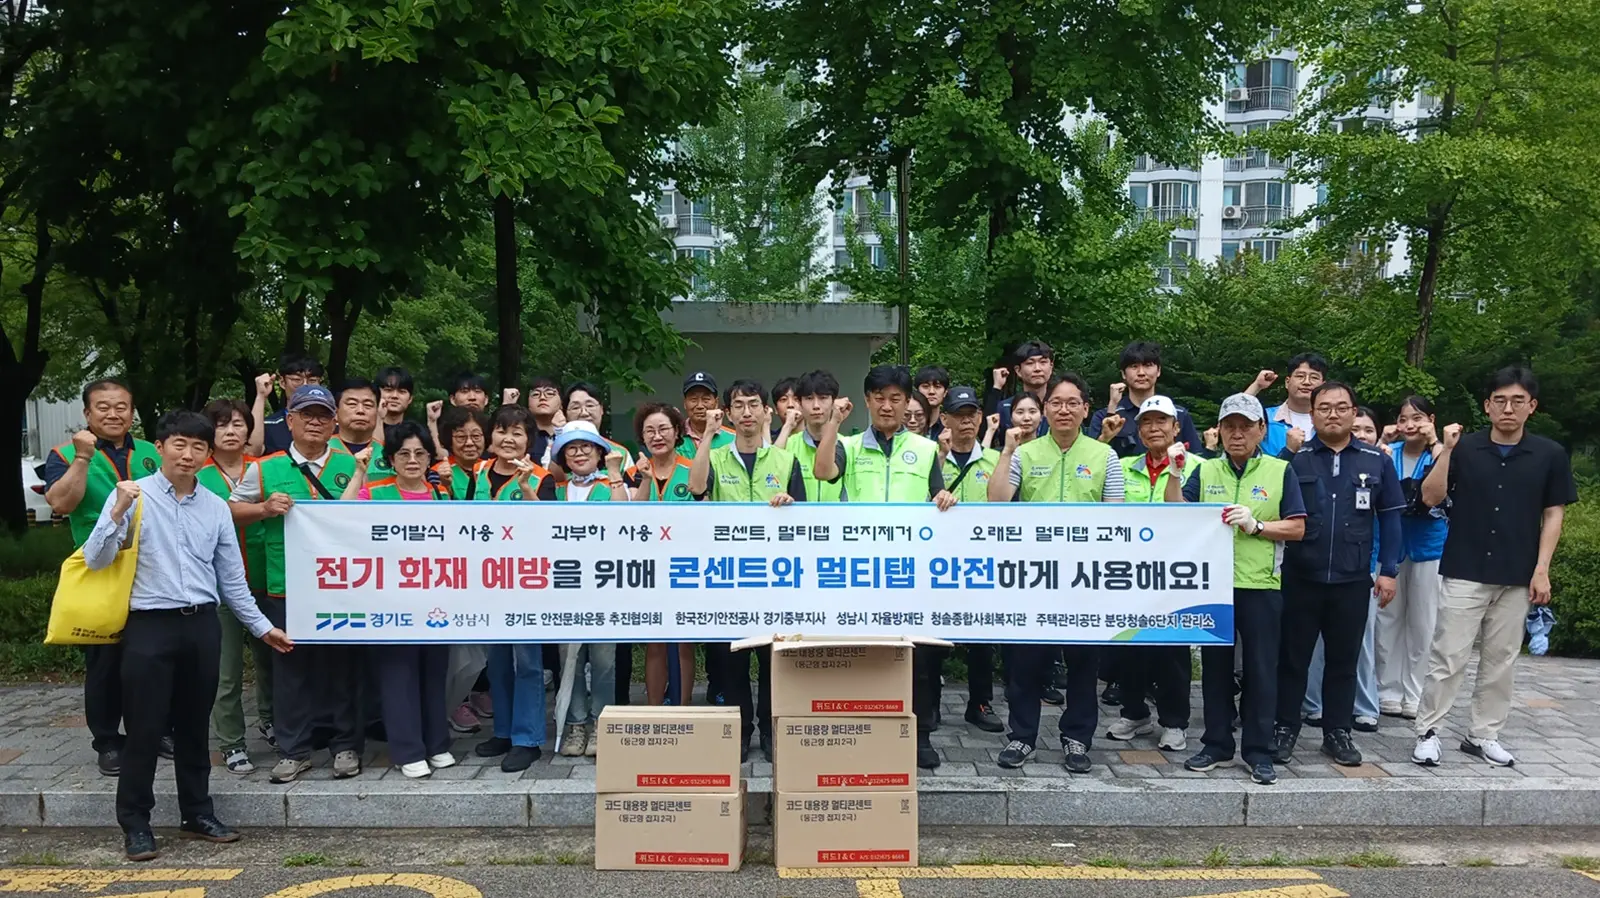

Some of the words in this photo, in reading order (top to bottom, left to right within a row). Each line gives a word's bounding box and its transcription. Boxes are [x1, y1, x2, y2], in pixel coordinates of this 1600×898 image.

[372, 525, 444, 541] 문어발식
[459, 525, 494, 542] 사용
[552, 525, 605, 541] 과부하
[619, 525, 652, 542] 사용
[714, 526, 770, 542] 콘센트,
[779, 526, 829, 541] 멀티탭
[843, 526, 911, 541] 먼지제거
[970, 526, 1022, 541] 오래된
[1036, 527, 1088, 542] 멀티탭
[1097, 526, 1131, 542] 교체
[316, 557, 383, 589] 전기
[399, 557, 467, 589] 화재
[482, 557, 581, 589] 예방을
[595, 559, 655, 588] 위해
[669, 557, 804, 588] 콘센트와
[817, 557, 915, 588] 멀티탭
[929, 557, 1058, 589] 안전하게
[1071, 561, 1209, 590] 사용해요!
[371, 613, 413, 627] 경기도
[453, 614, 489, 626] 성남시
[505, 613, 536, 626] 경기도
[541, 612, 605, 626] 안전문화운동
[609, 612, 662, 625] 추진협의회
[676, 612, 759, 625] 한국전기안전공사
[764, 612, 826, 625] 경기중부지사
[837, 612, 867, 625] 성남시
[872, 612, 924, 625] 자율방재단
[931, 612, 1027, 626] 청솔종합사회복지관
[1036, 614, 1101, 627] 주택관리공단
[1104, 612, 1180, 628] 분당청솔6단지
[1180, 613, 1215, 629] 관리소
[606, 724, 623, 734] 코드
[625, 724, 650, 734] 대용량
[653, 724, 694, 734] 멀티콘센트
[786, 725, 802, 735] 코드
[804, 725, 829, 735] 대용량
[831, 724, 871, 735] 멀티콘센트
[605, 800, 621, 810] 코드
[623, 801, 648, 811] 대용량
[651, 801, 692, 812] 멀티콘센트
[786, 800, 802, 810] 코드
[804, 800, 829, 810] 대용량
[831, 800, 872, 810] 멀티콘센트
